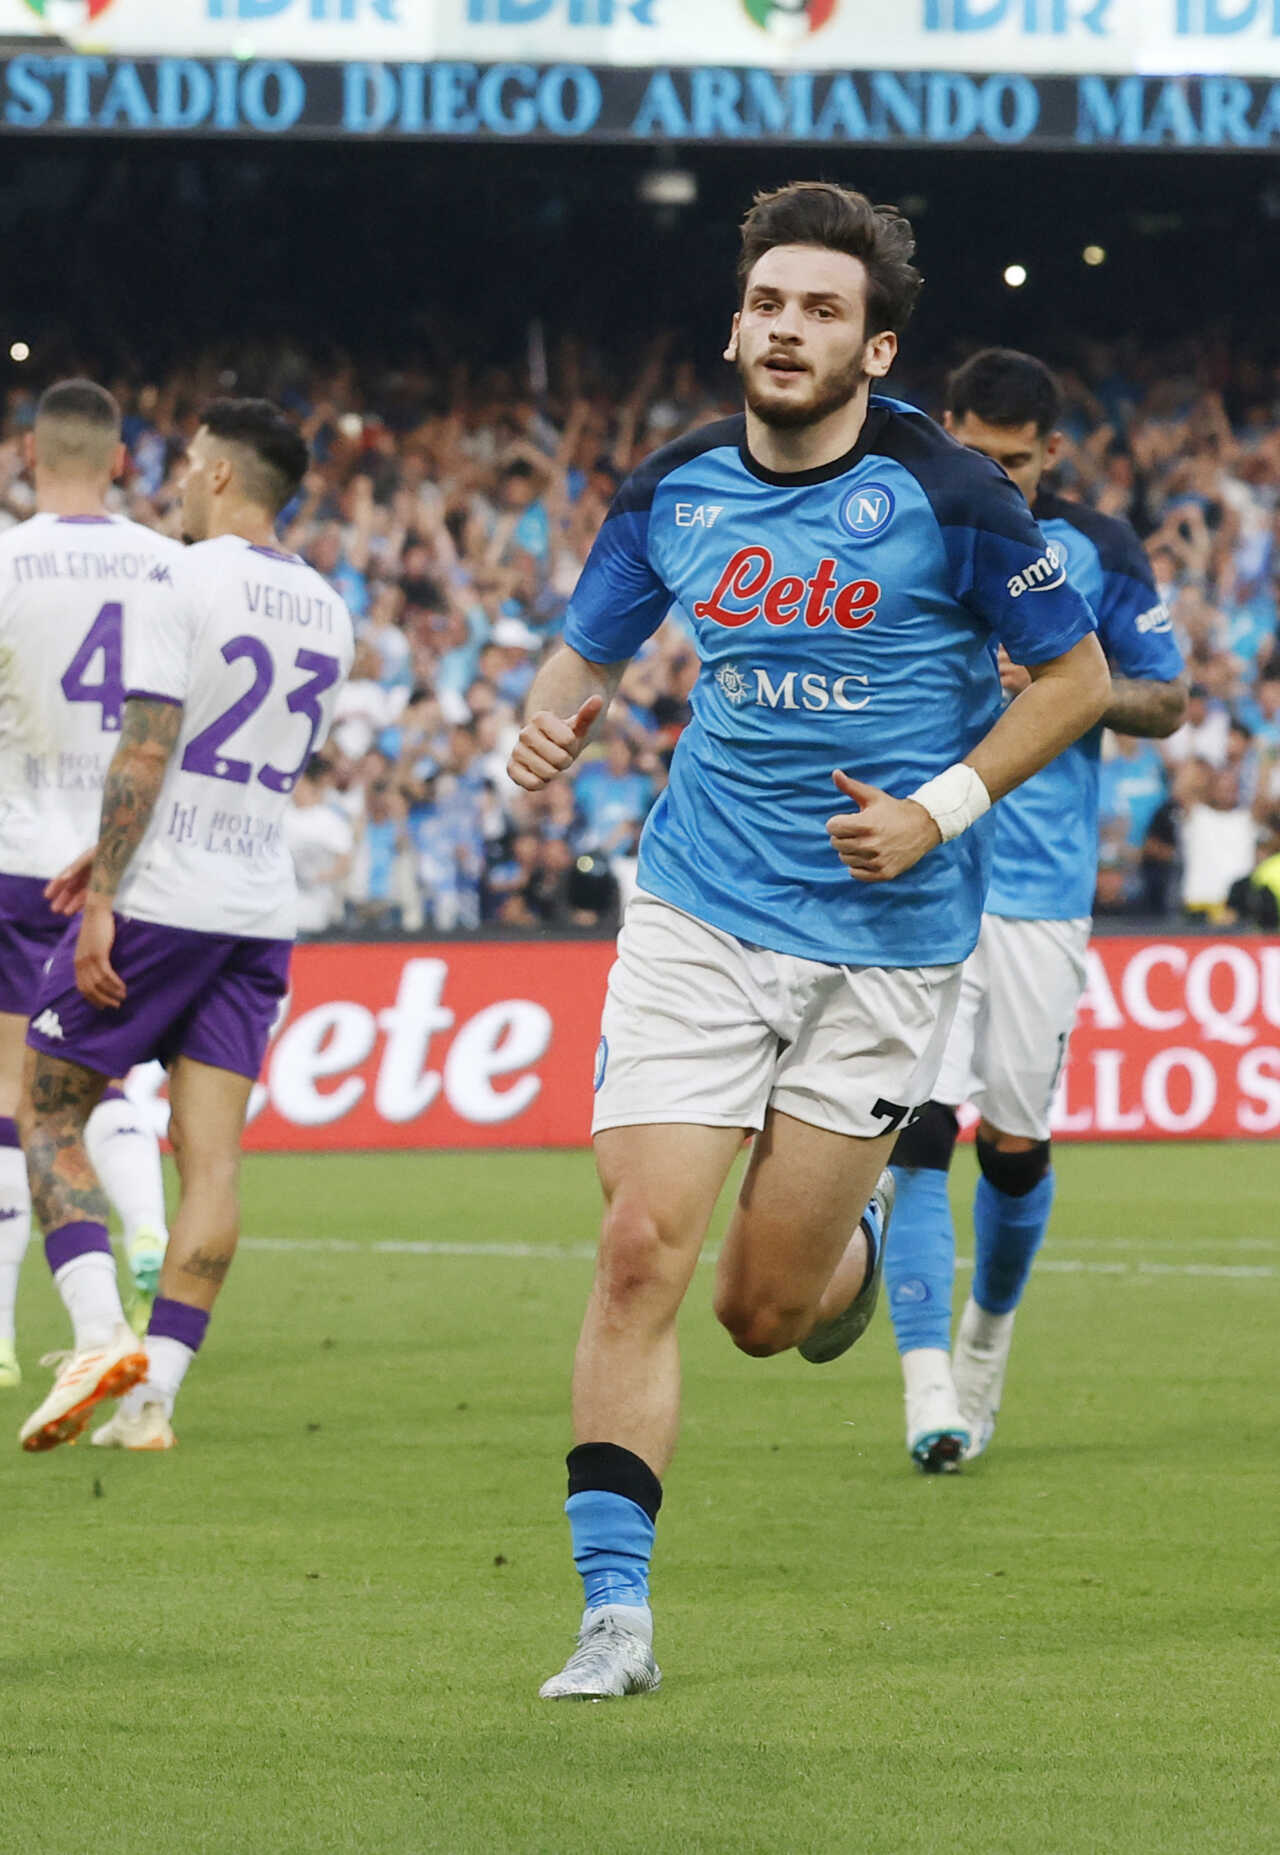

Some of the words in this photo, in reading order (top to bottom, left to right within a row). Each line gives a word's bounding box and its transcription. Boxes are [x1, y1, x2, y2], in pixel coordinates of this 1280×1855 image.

[4, 54, 306, 131] STADIO
[341, 61, 603, 136] DIEGO
[631, 66, 1041, 144] ARMANDO
[674, 502, 725, 529] EA7
[243, 580, 333, 634] VENUTI
[693, 545, 882, 630] Lete
[60, 601, 125, 732] 4
[751, 668, 871, 712] MSC
[181, 635, 340, 794] 23
[122, 956, 554, 1138] ete
